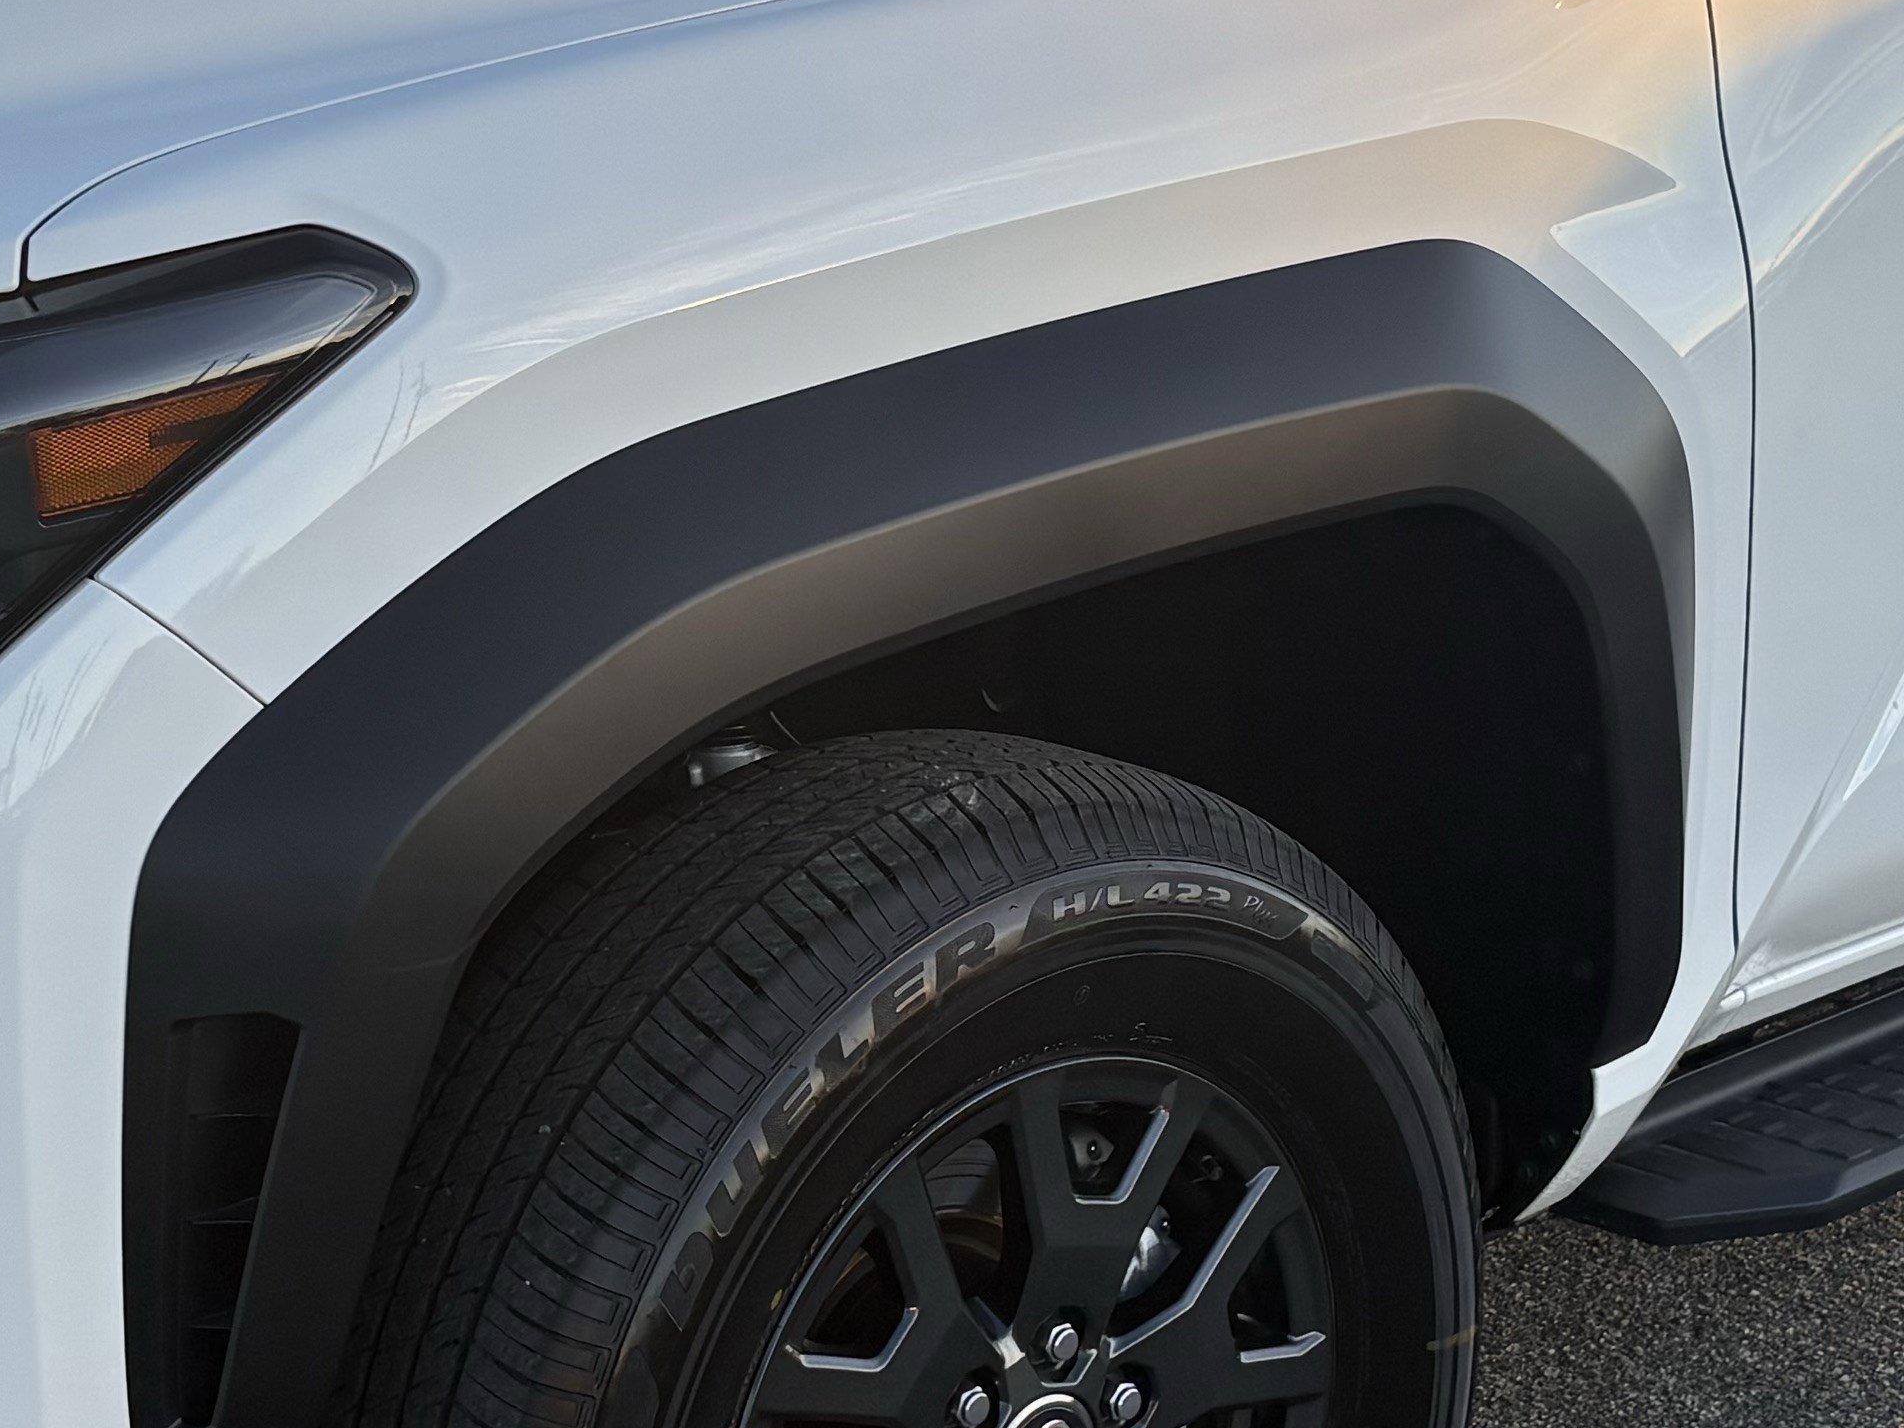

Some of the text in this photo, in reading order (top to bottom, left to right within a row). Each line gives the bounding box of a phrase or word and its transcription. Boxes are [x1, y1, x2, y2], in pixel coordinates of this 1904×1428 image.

[1052, 884, 1136, 921] H/L
[1143, 881, 1231, 909] 422
[659, 920, 1000, 1332] DUELER
